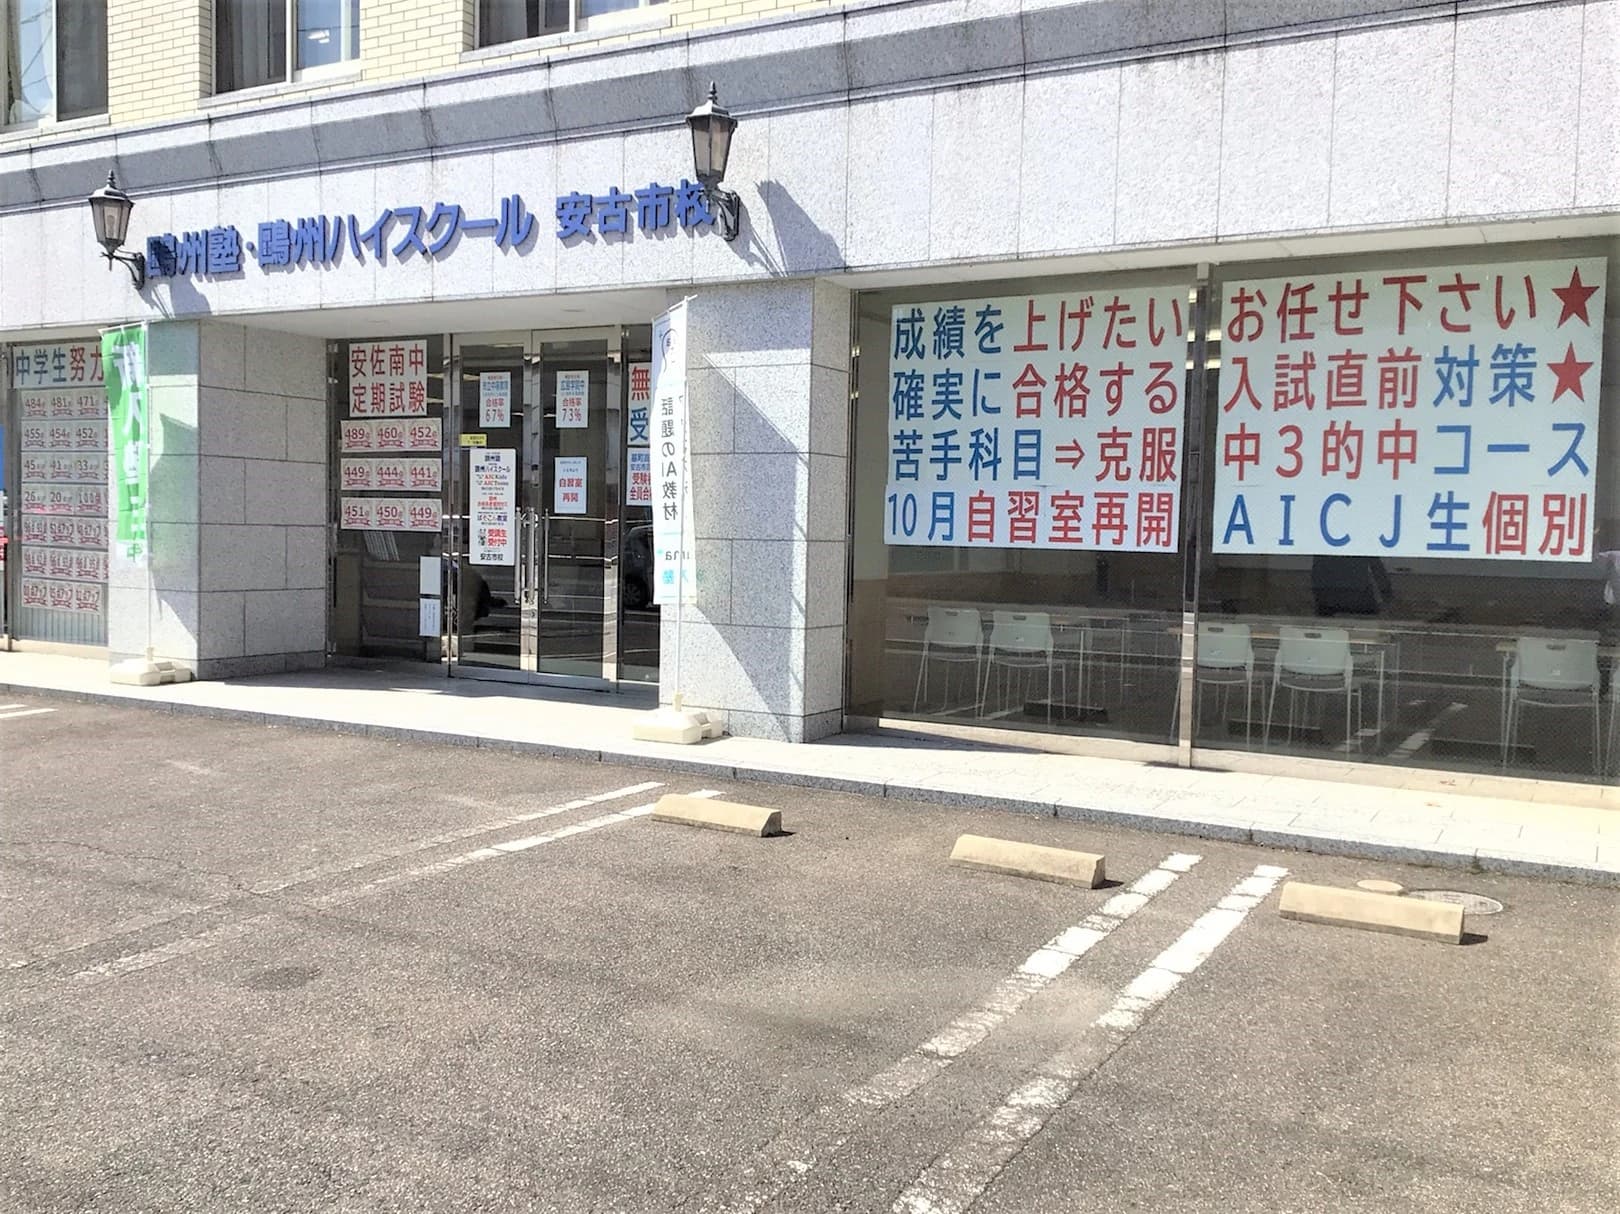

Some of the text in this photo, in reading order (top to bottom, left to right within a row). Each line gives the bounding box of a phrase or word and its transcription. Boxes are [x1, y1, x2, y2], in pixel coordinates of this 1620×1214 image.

[557, 179, 717, 239] 安古市校
[894, 296, 1183, 360] 成績を上げたい
[1227, 273, 1537, 343] お任せ下さい
[16, 345, 104, 385] 中学生努力
[351, 343, 424, 378] 安佐南中
[1223, 343, 1538, 412] 入試直前対策
[352, 381, 425, 413] 定期試験
[892, 361, 1178, 421] 確実に合格する
[1223, 418, 1590, 481] 中3的中コース
[630, 486, 652, 500] 全員合
[888, 489, 1174, 547] 10月自習室再開
[1222, 490, 1588, 556] AICJ生個別
